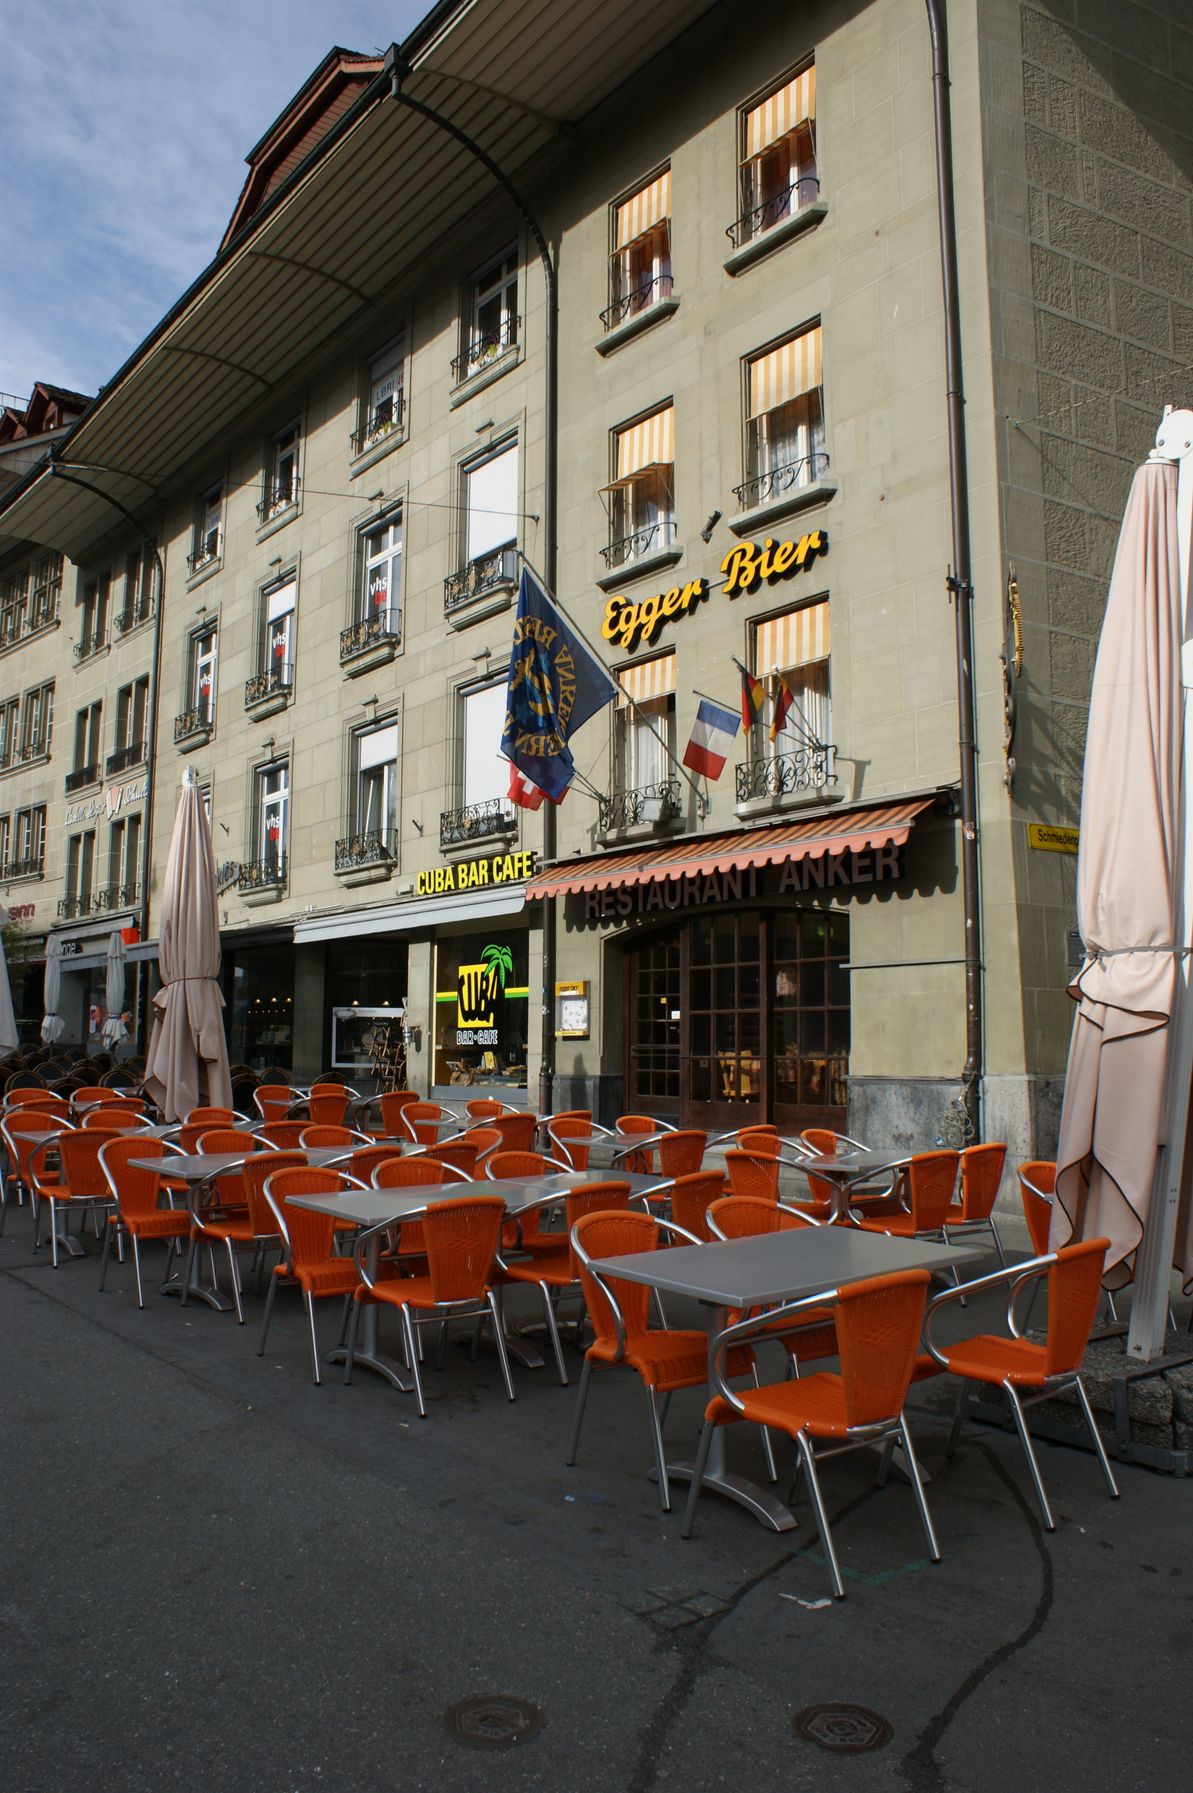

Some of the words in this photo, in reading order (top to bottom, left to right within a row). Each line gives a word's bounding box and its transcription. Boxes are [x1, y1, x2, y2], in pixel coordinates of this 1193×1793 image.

[600, 578, 702, 650] Egger
[719, 531, 821, 594] Bier
[417, 865, 455, 896] CUBA
[457, 859, 489, 890] BAR
[492, 850, 532, 884] CAFE
[584, 867, 758, 919] RESTAURANT
[778, 846, 901, 893] ANKER
[456, 1030, 474, 1046] BAR
[477, 1029, 499, 1046] CAFE
